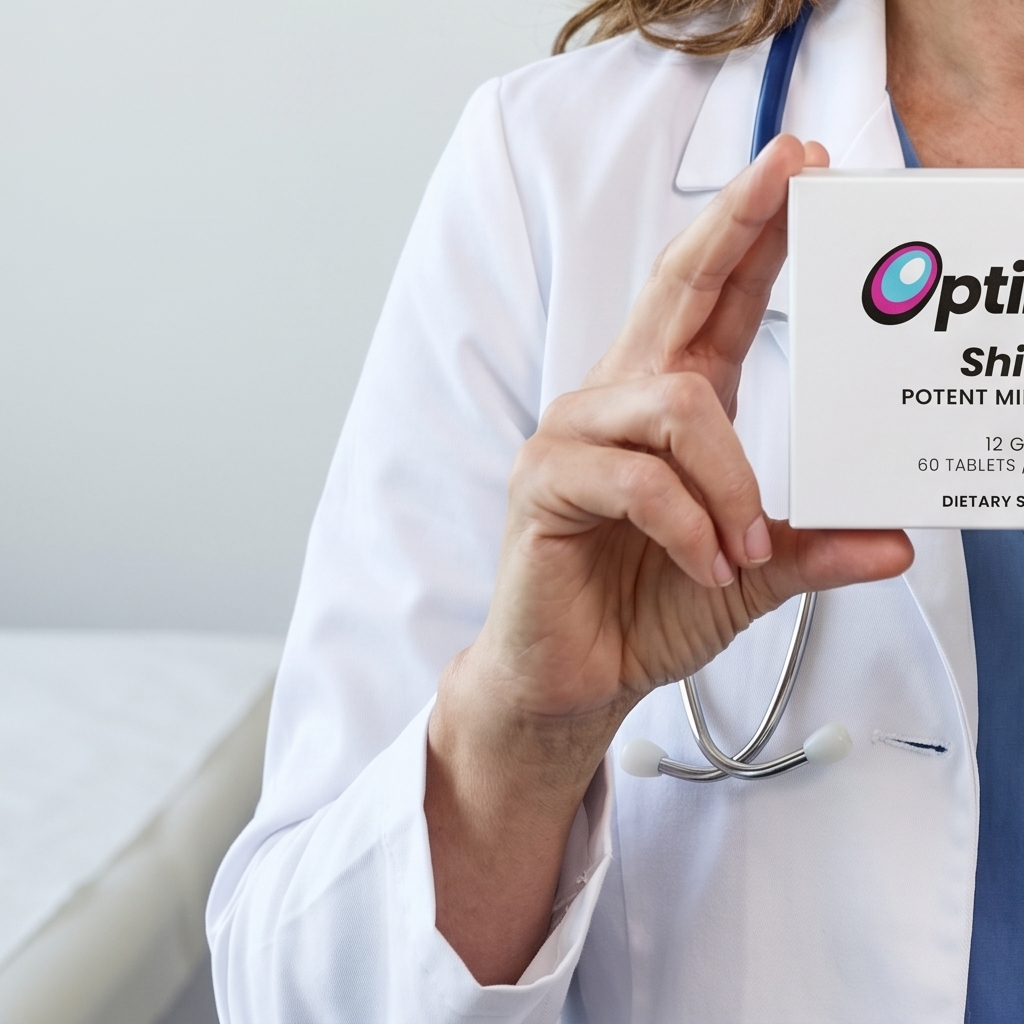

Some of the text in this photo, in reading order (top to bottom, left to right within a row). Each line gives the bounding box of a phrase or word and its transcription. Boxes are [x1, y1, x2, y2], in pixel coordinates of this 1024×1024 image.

[901, 388, 988, 406] POTENT
[985, 436, 1003, 452] 12
[917, 457, 940, 473] 60
[945, 457, 1016, 473] TABLETS
[942, 494, 1012, 509] DIETARY
